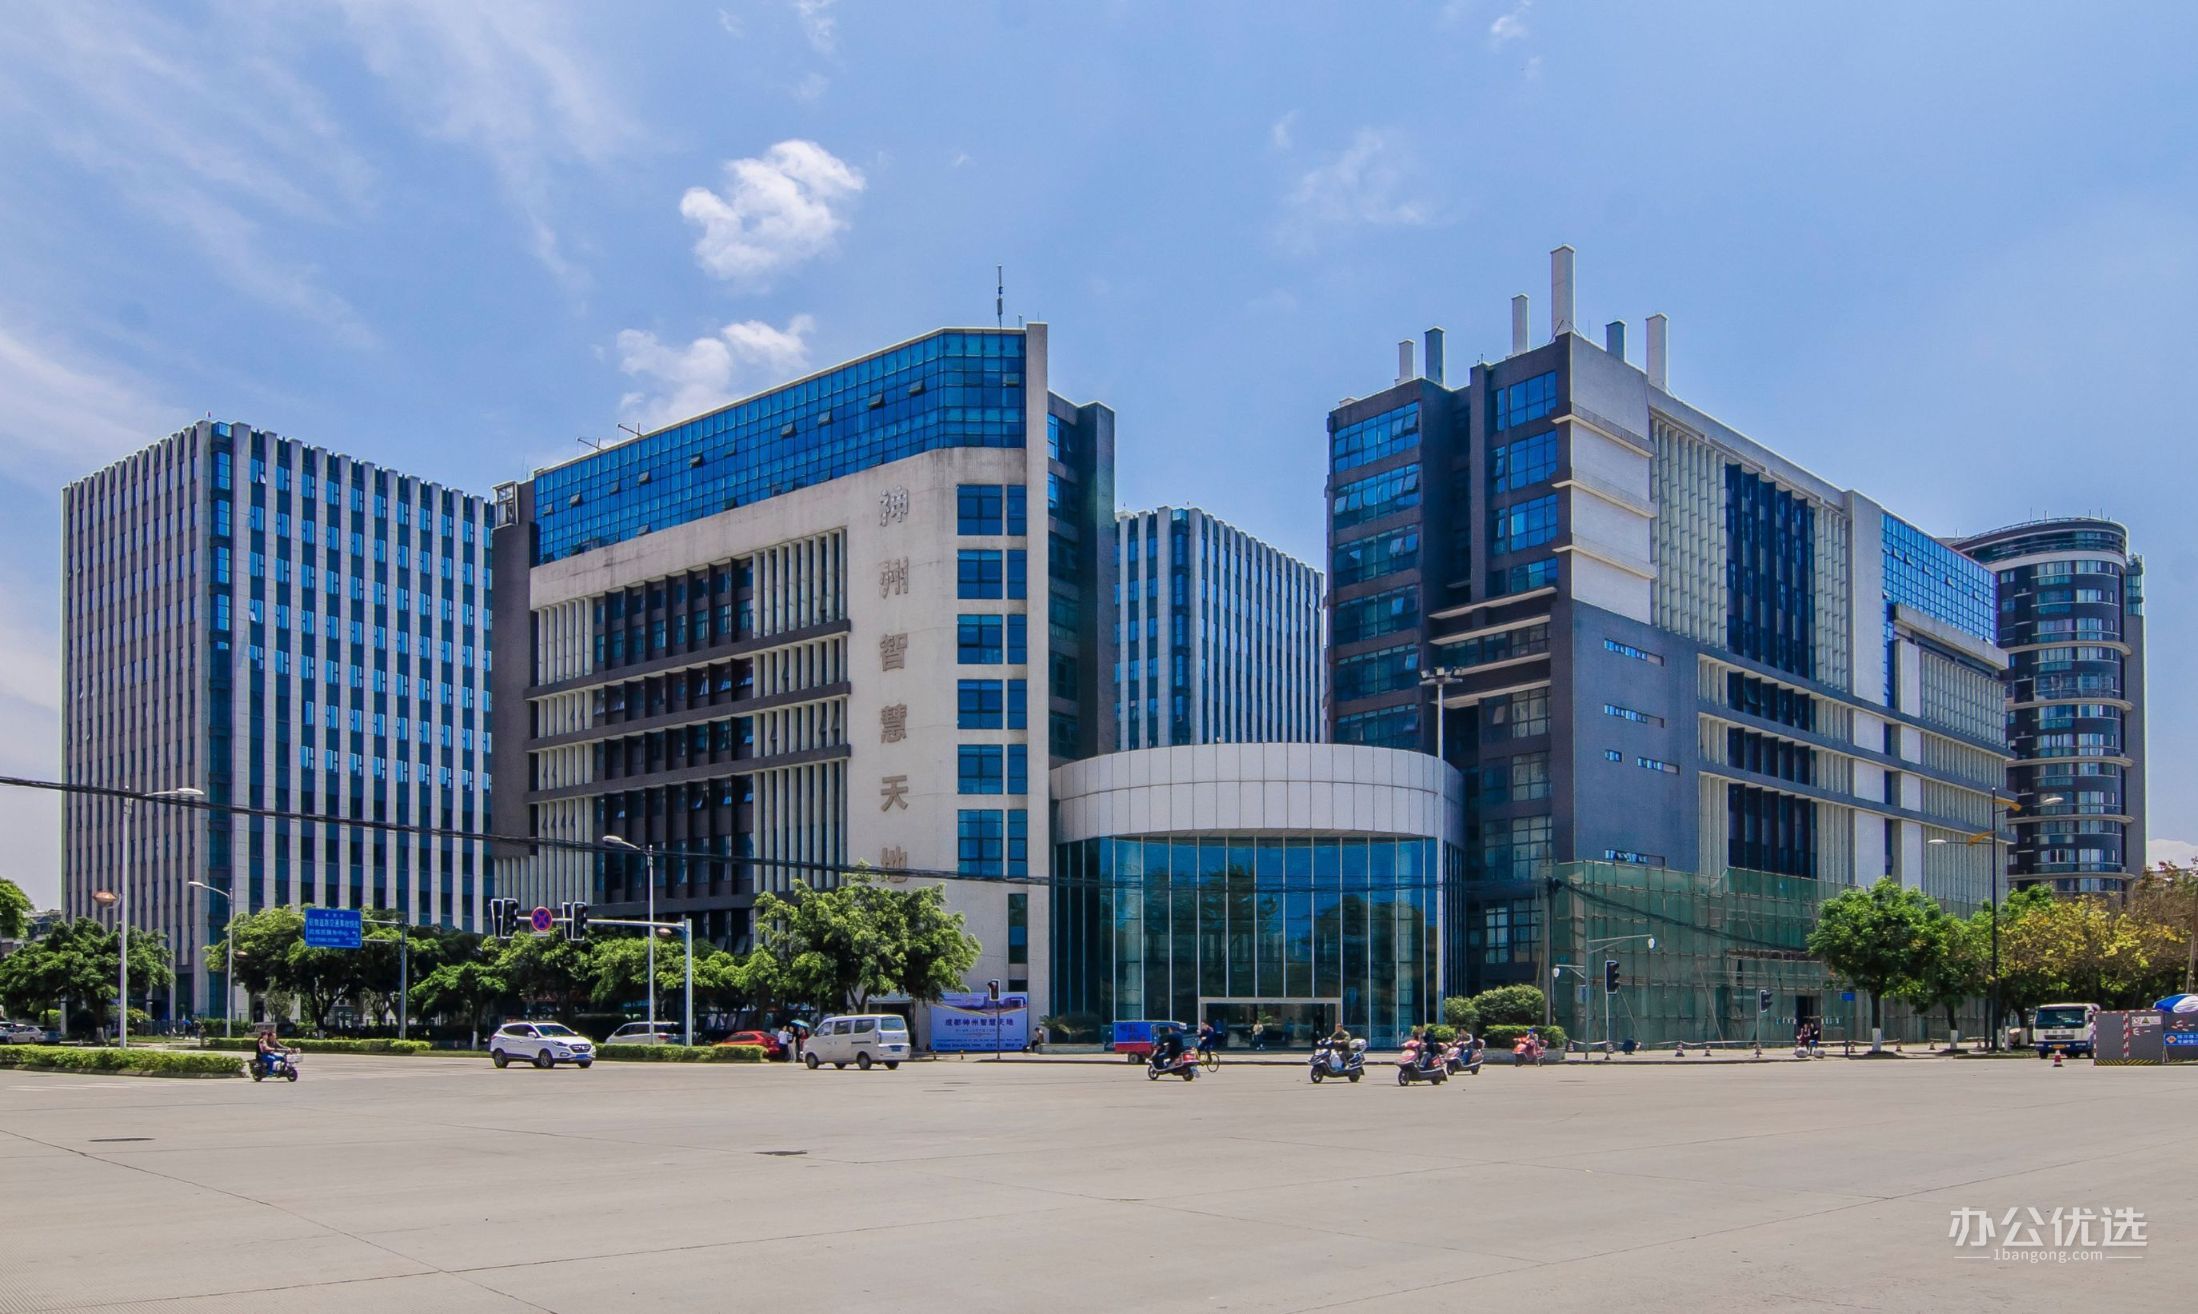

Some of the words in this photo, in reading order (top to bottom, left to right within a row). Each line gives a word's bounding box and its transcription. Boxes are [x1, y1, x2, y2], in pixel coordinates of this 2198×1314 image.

[879, 486, 909, 884] 神州智慧天地
